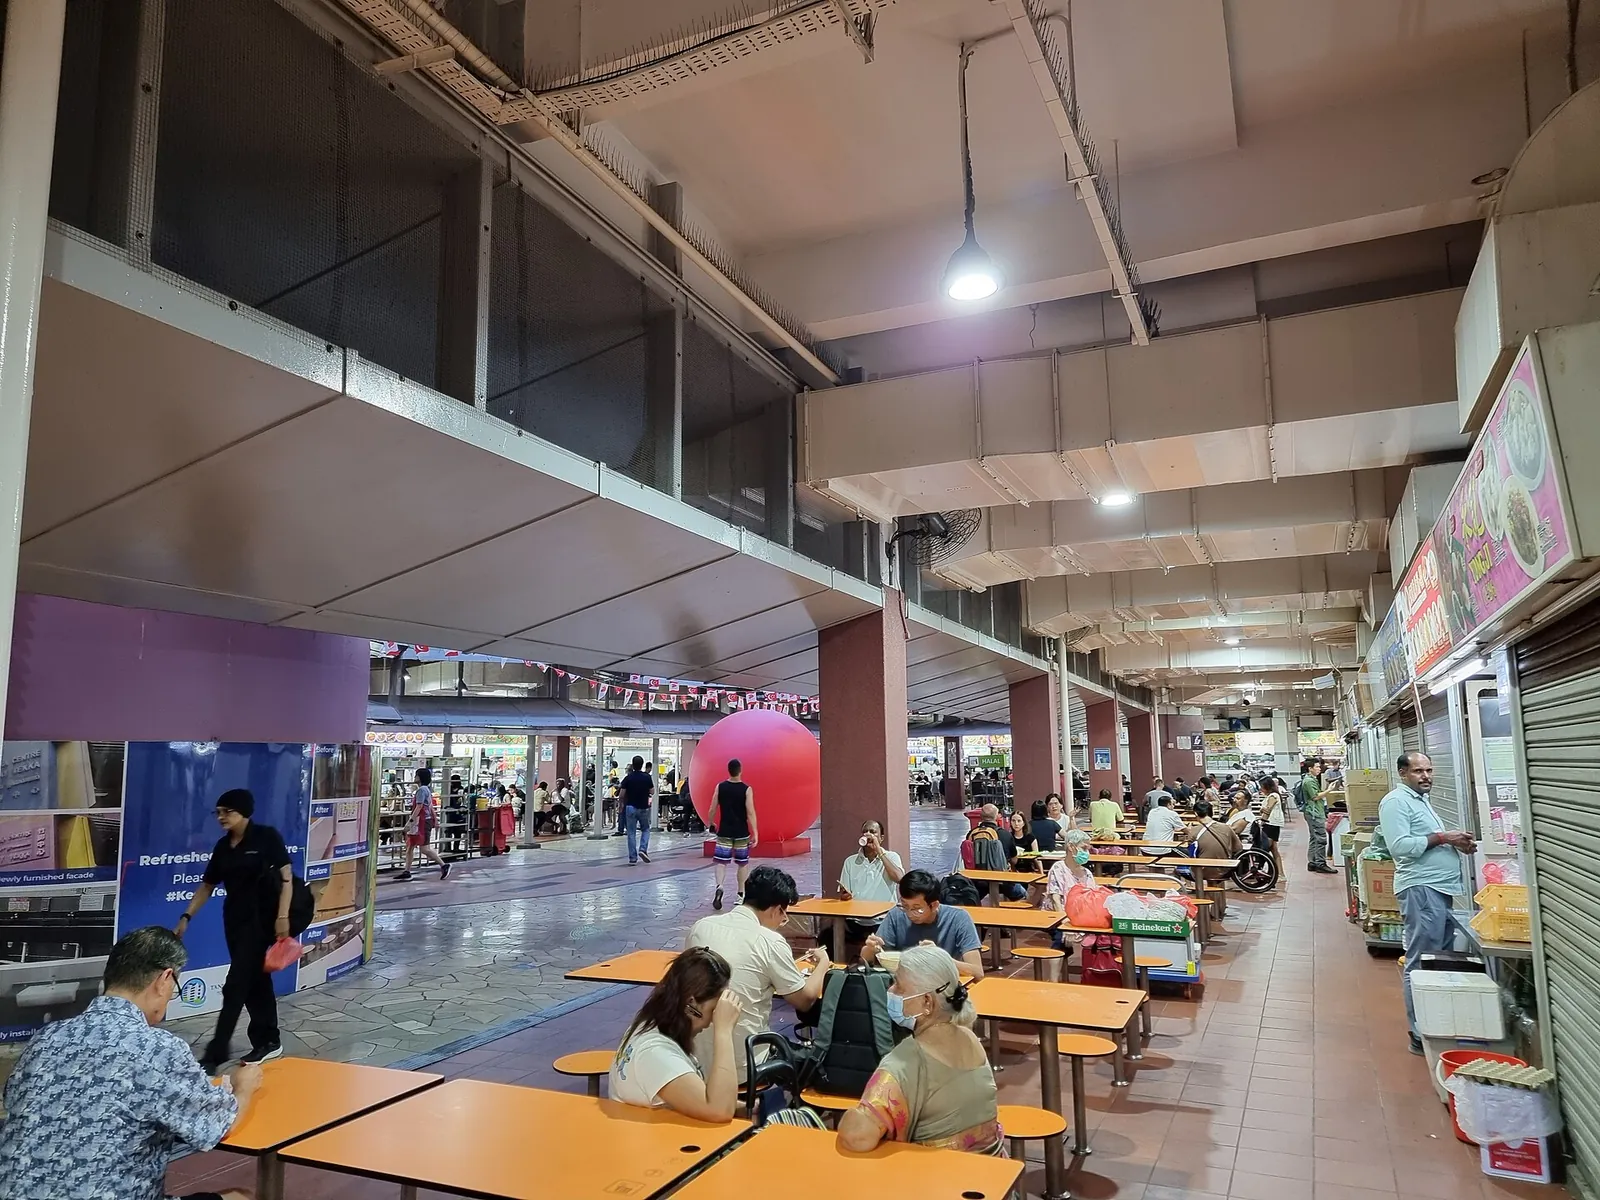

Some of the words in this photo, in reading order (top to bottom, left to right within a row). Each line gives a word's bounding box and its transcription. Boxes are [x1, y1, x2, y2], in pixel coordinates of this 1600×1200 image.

[314, 805, 330, 815] After
[0, 875, 22, 883] ewly
[23, 873, 65, 882] furnished
[66, 871, 94, 880] facade
[308, 866, 328, 877] Before
[173, 873, 205, 885] Pleas
[1131, 922, 1171, 932] Heineken
[306, 929, 323, 940] After
[9, 1027, 38, 1038] install
